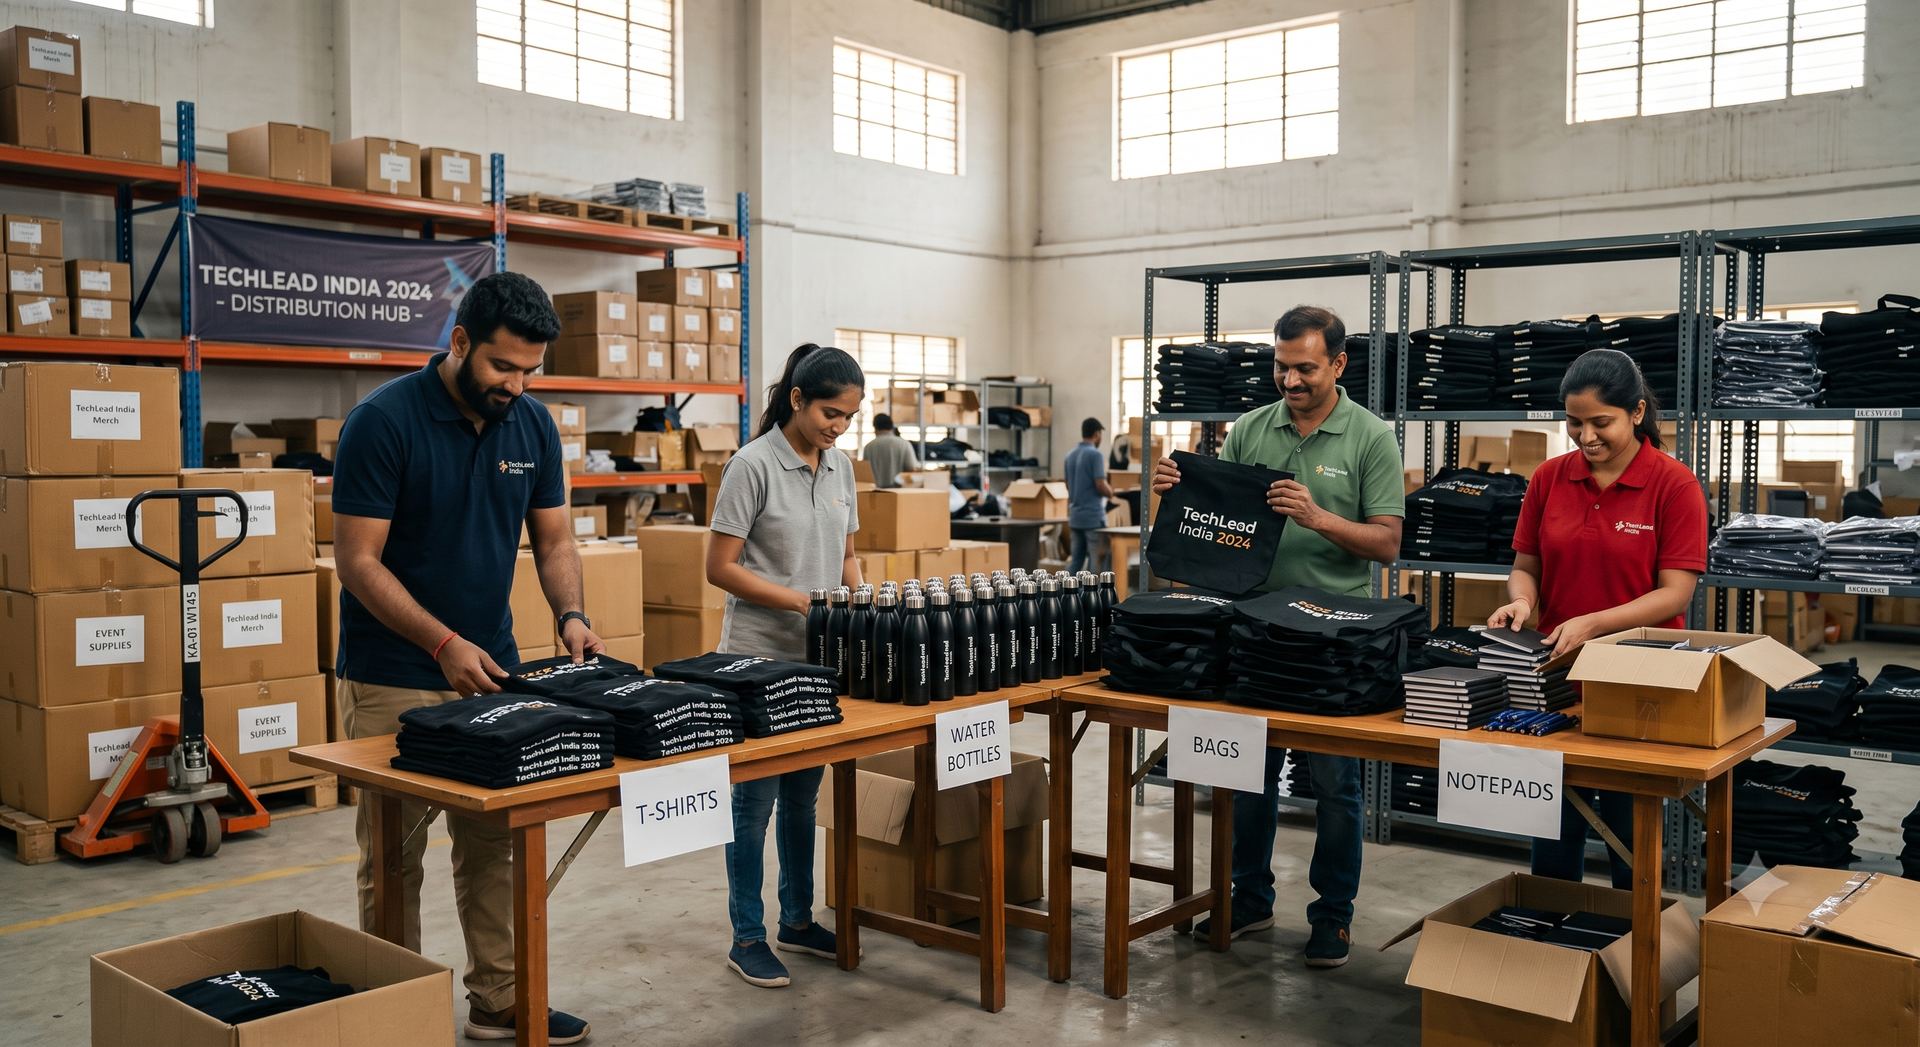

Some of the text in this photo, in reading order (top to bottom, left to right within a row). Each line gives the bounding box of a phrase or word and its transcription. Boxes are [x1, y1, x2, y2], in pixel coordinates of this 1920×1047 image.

[199, 264, 433, 301] TECHLEAD INDIA 2024
[231, 294, 366, 320] DISTRIBUTION
[372, 305, 411, 322] HUB
[76, 404, 113, 412] TechLead
[79, 513, 116, 521] TechLead
[1184, 506, 1257, 534] TechLead
[96, 524, 122, 532] Merch
[1178, 521, 1251, 549] India 2024
[186, 591, 197, 624] W145
[96, 628, 126, 638] EVENT
[89, 641, 132, 651] SUPPLIES
[256, 716, 280, 726] EVENT
[250, 727, 287, 740] SUPPLIES
[698, 730, 714, 738] India
[950, 720, 996, 744] WATER
[94, 741, 130, 753] TechLead
[697, 740, 714, 748] India
[1193, 736, 1240, 759] BAGS
[947, 745, 1001, 772] BOTTLES
[1446, 771, 1554, 802] NOTEPADS
[636, 789, 718, 826] T-SHIRTS
